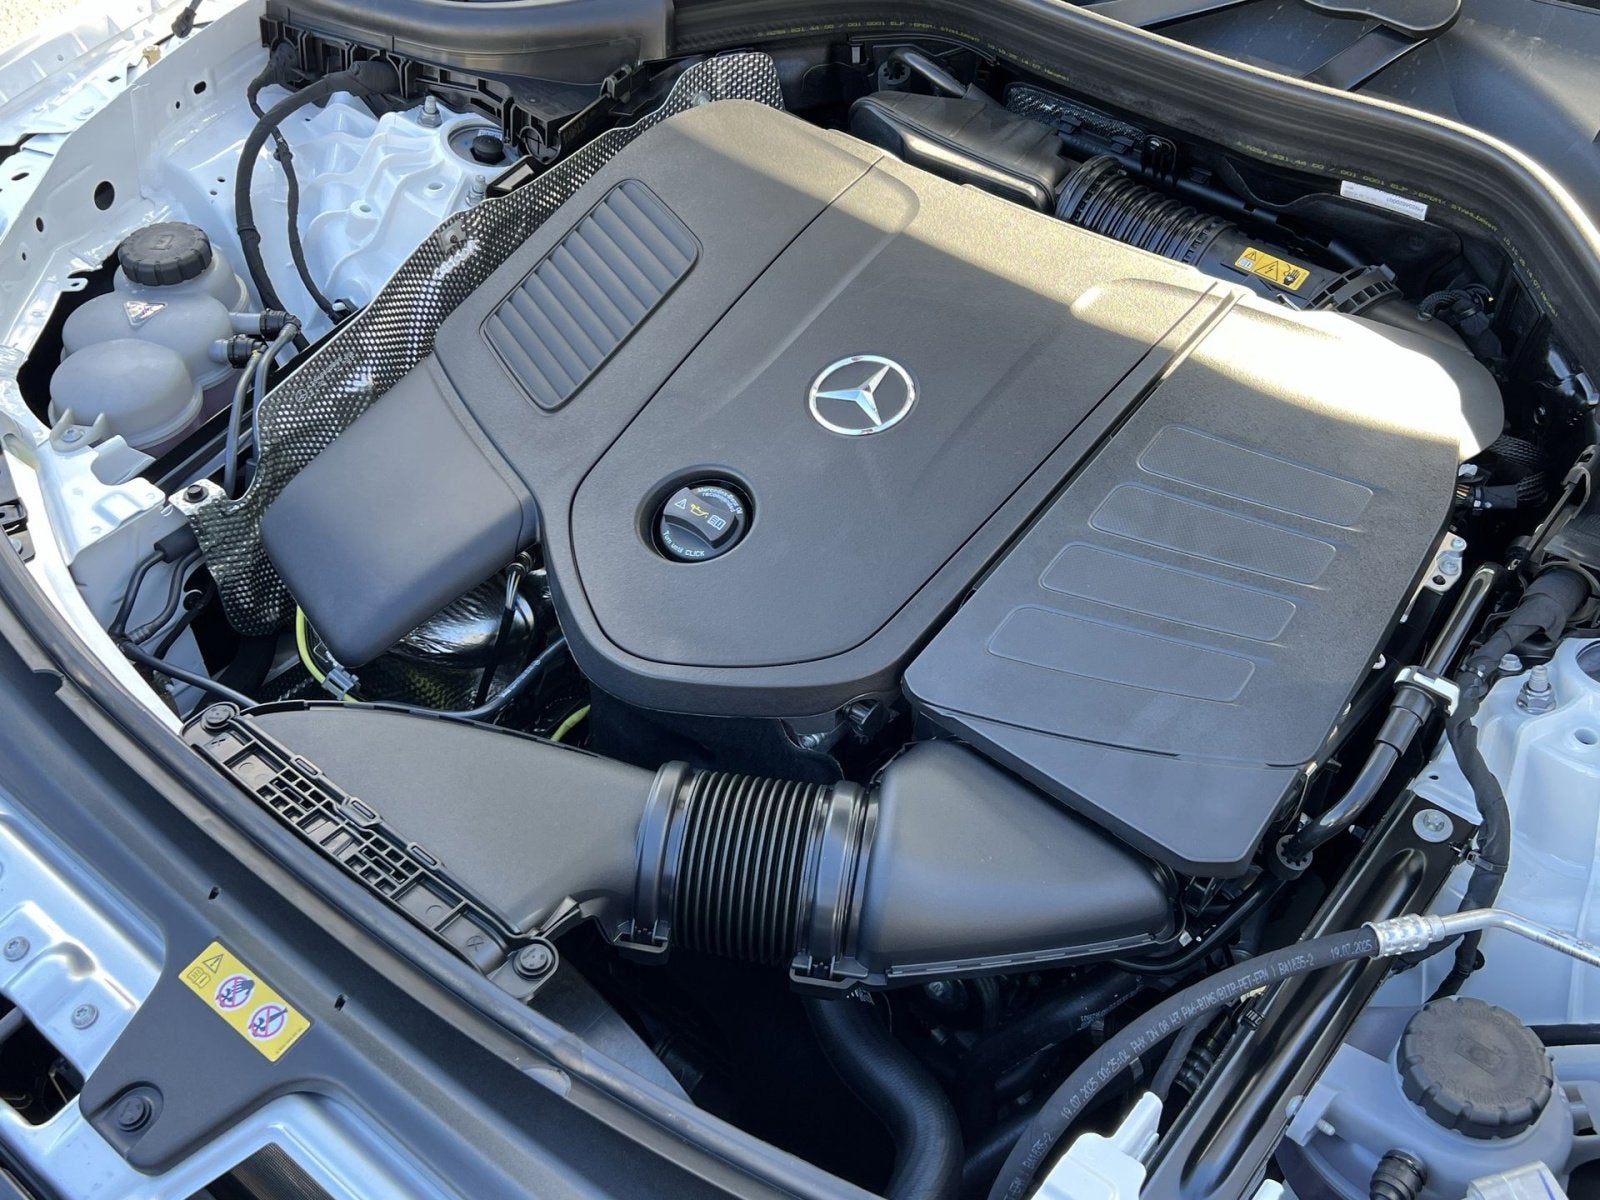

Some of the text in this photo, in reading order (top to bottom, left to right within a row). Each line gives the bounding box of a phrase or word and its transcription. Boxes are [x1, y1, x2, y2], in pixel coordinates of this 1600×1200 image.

[663, 530, 673, 545] Turn
[684, 549, 705, 557] CLICK
[1061, 1077, 1098, 1119] 19.07.2025
[1146, 1027, 1159, 1041] DN
[1159, 1021, 1169, 1034] 08
[1329, 939, 1373, 959] 19.07.2025
